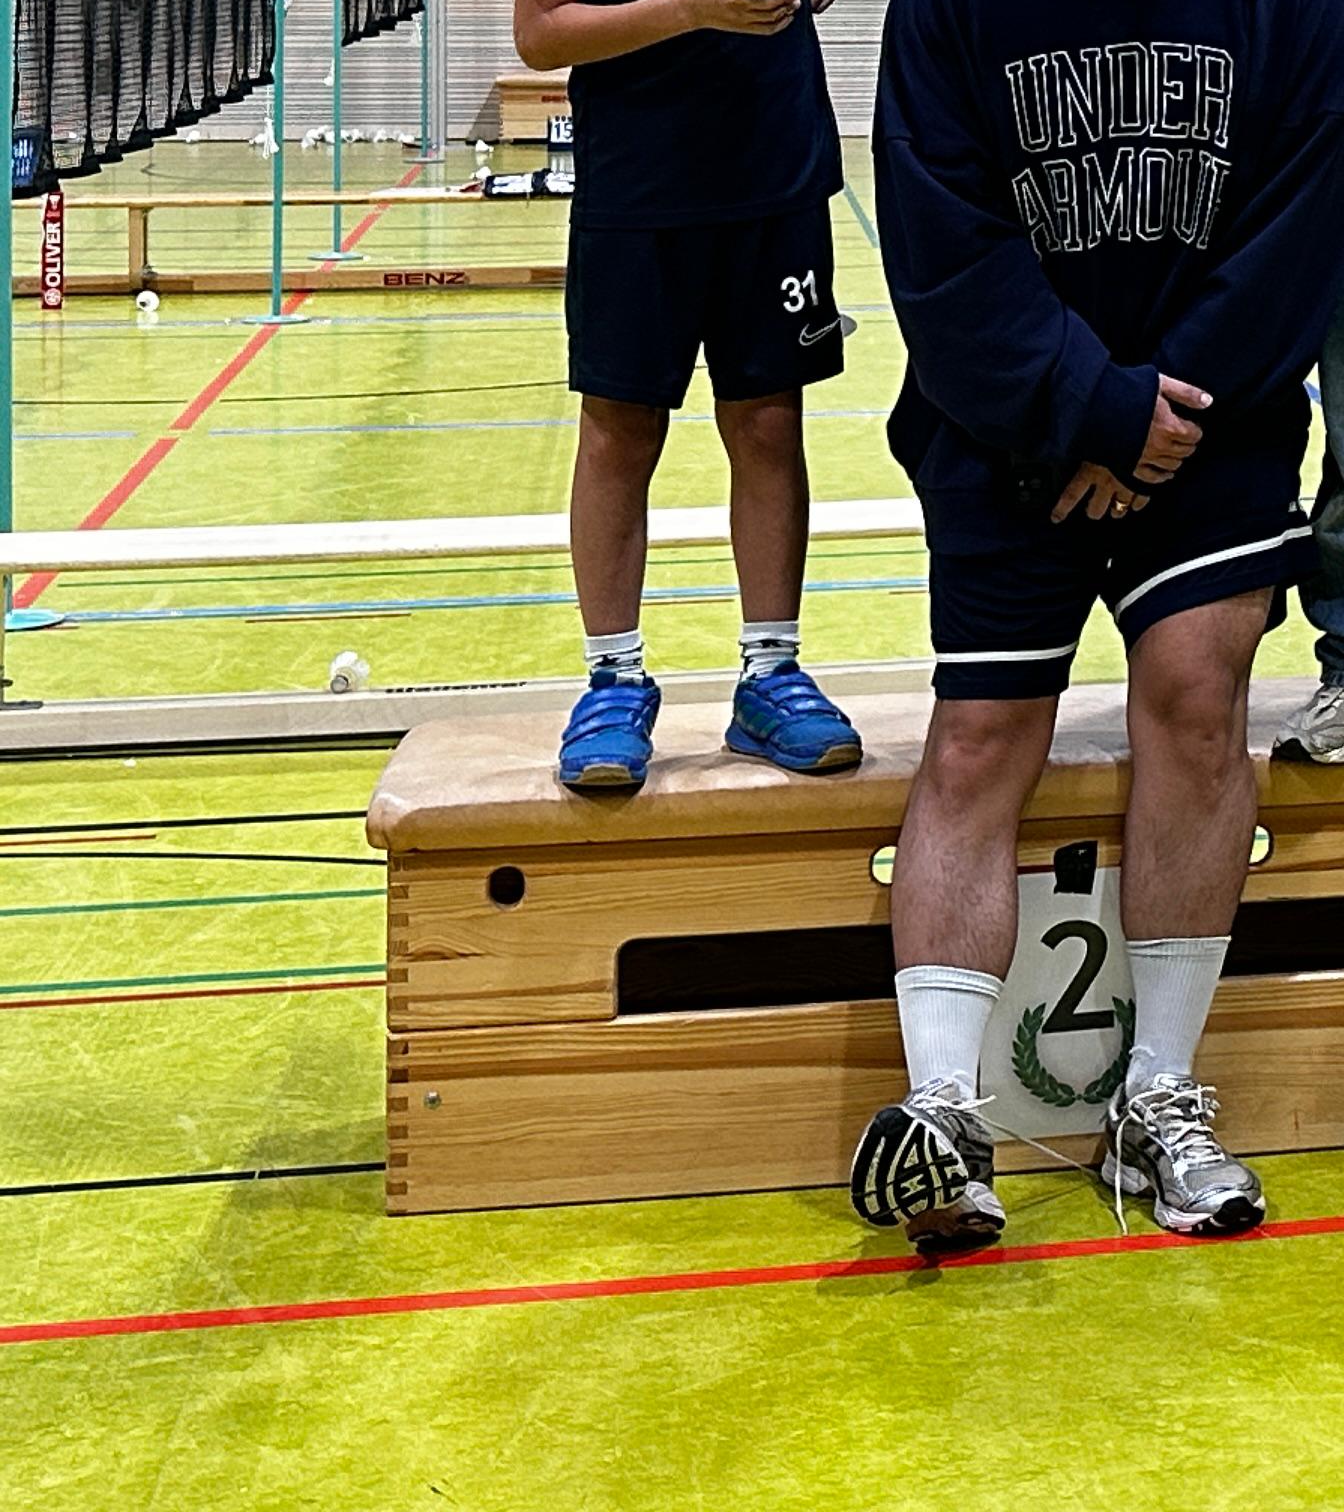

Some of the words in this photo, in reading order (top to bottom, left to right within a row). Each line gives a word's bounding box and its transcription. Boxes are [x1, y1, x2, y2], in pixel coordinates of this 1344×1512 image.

[1004, 41, 1234, 153] UNDER
[45, 221, 61, 287] OLIVER
[383, 272, 465, 286] BENZ
[780, 269, 819, 313] 31
[1039, 919, 1115, 1034] 2
